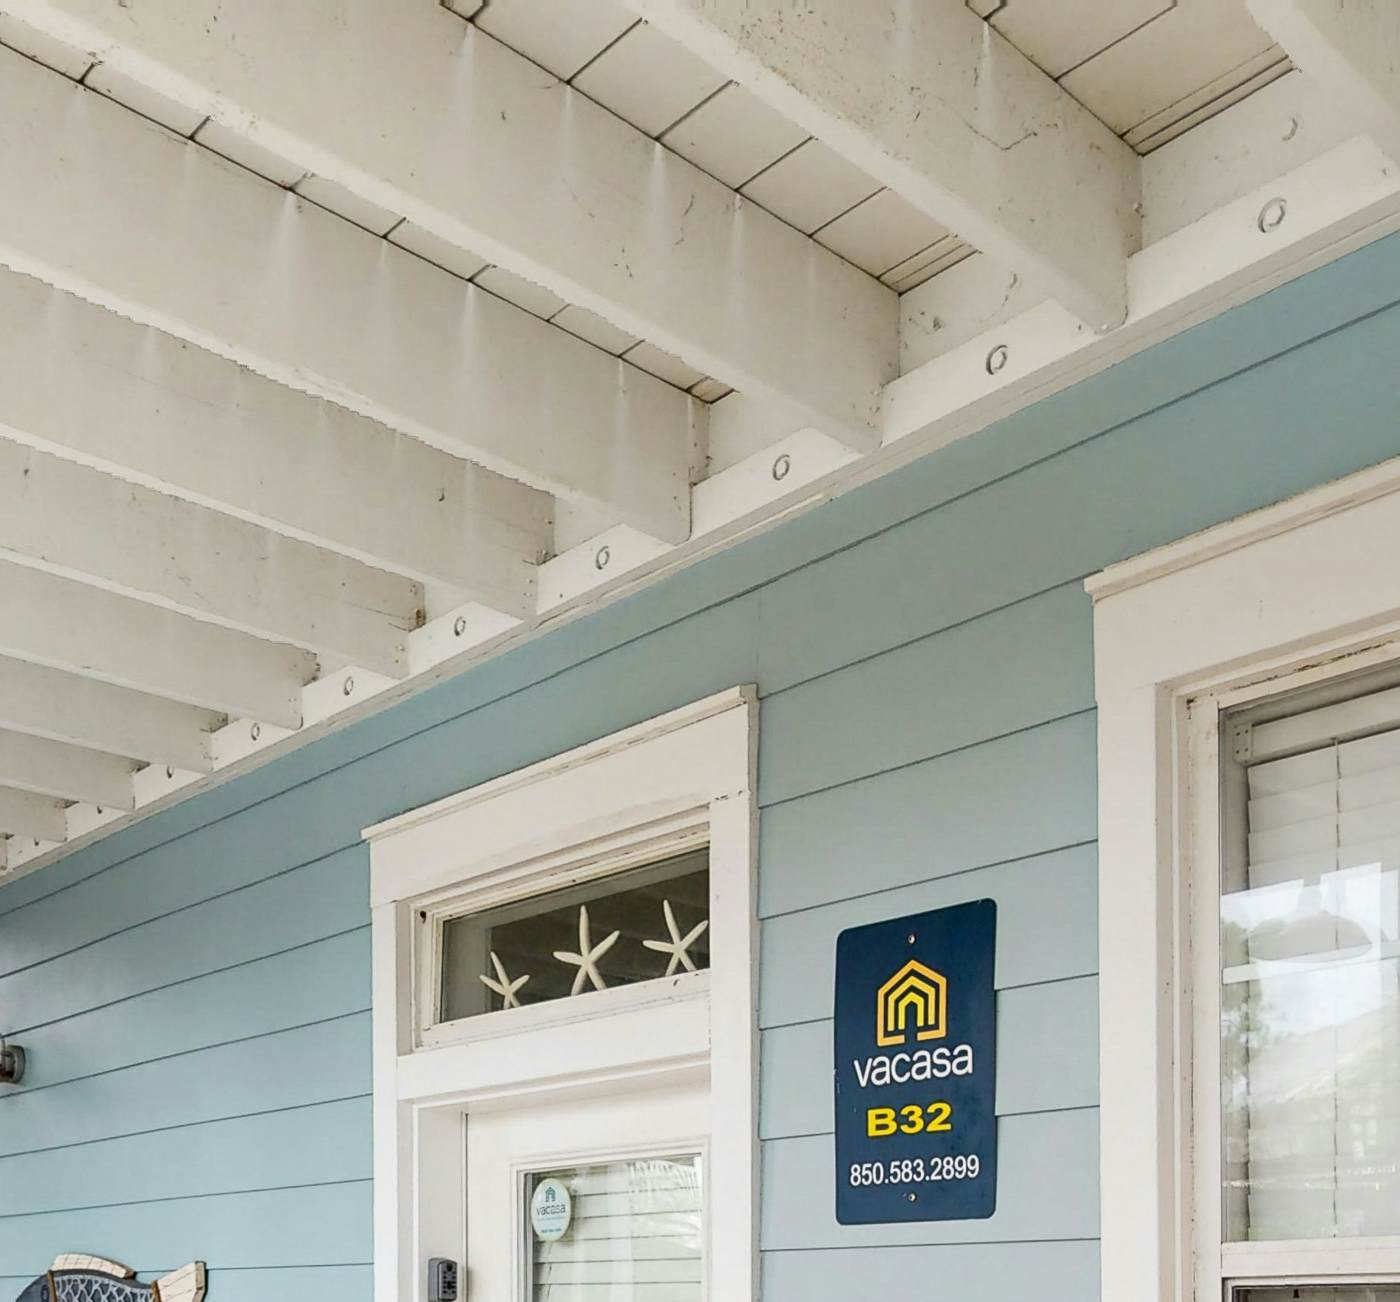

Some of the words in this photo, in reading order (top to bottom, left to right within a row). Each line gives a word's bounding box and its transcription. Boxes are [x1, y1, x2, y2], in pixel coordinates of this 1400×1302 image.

[852, 1043, 973, 1088] vacasa
[867, 1102, 952, 1137] B32
[849, 1154, 980, 1187] 850.583.2899
